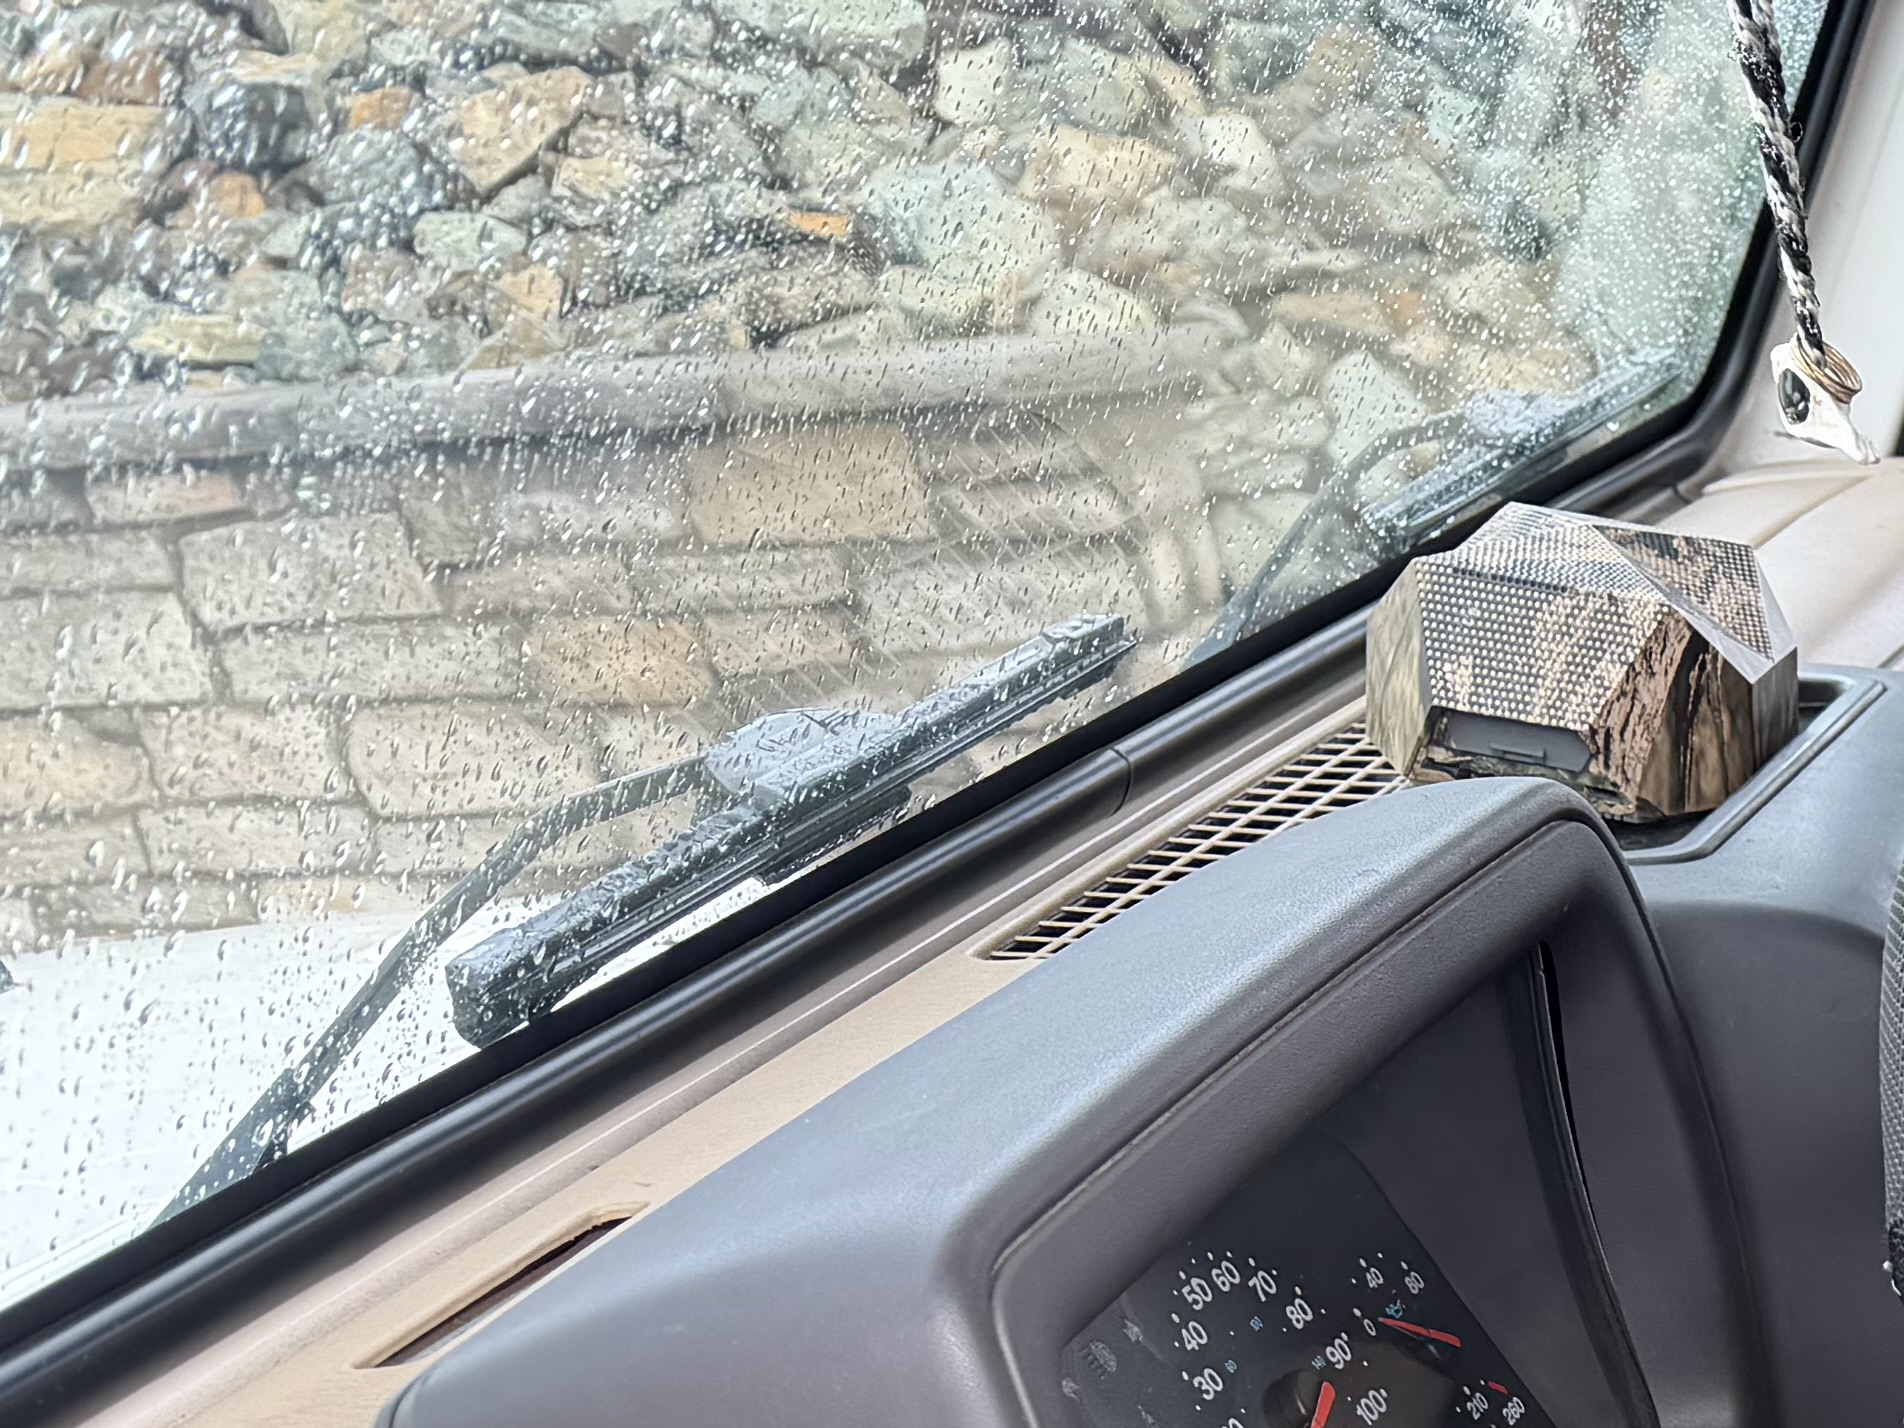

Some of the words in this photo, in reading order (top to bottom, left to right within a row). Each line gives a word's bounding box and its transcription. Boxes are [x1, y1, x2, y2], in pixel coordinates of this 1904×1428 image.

[1211, 1260, 1241, 1292] 60
[1249, 1271, 1277, 1302] 70
[1366, 1267, 1384, 1289] 40
[1182, 1277, 1213, 1311] 50
[1285, 1298, 1313, 1330] 80
[1363, 1318, 1377, 1337] 0
[1180, 1321, 1208, 1352] 40
[1326, 1338, 1352, 1369] 90
[1193, 1367, 1223, 1400] 30
[1356, 1388, 1387, 1426] 100
[1467, 1392, 1488, 1421] 210
[1502, 1397, 1526, 1426] 260
